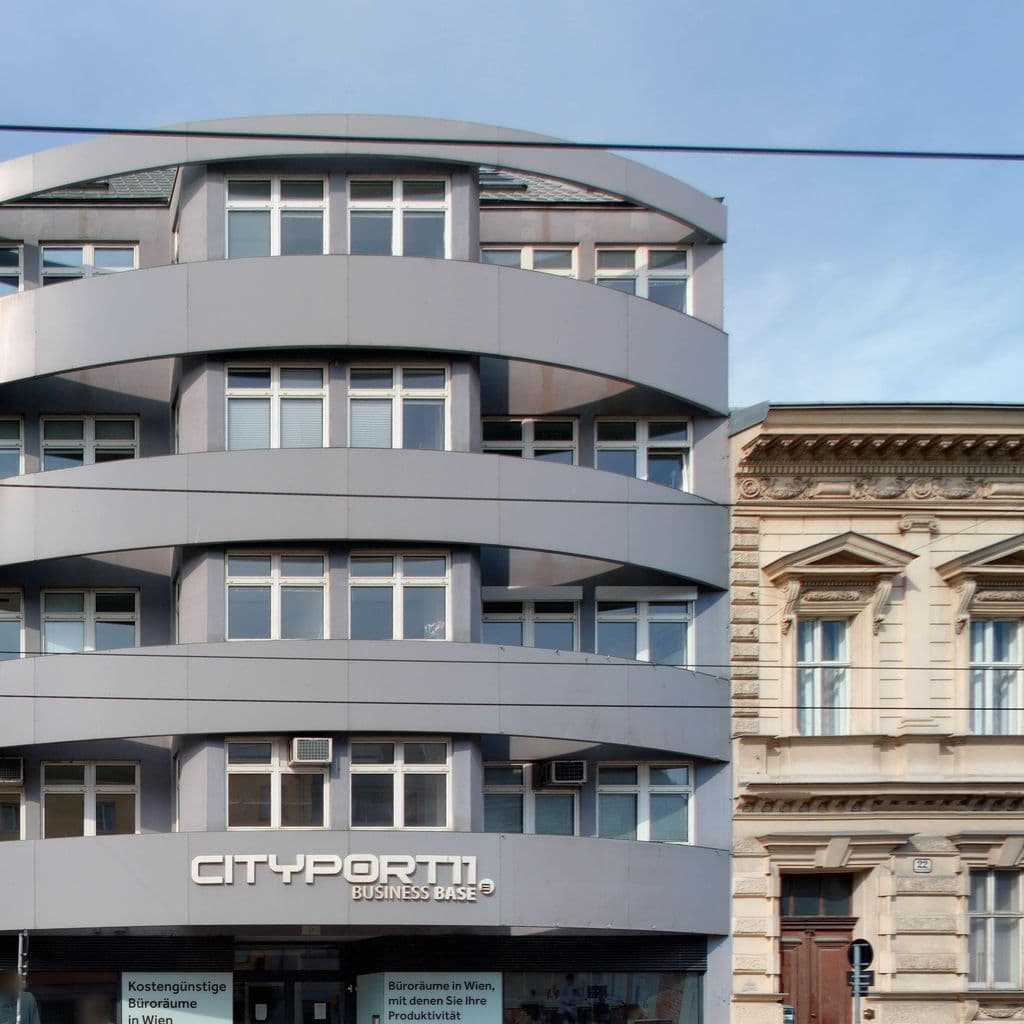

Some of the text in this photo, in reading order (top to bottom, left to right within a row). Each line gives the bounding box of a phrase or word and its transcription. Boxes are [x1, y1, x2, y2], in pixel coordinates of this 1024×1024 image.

[191, 854, 477, 885] CITYPORT11
[352, 884, 477, 901] BUSINESS BASE
[128, 981, 227, 994] Kostengünstige
[389, 981, 495, 992] Büroräume in Wien,
[128, 998, 198, 1009] Büroräume
[389, 996, 487, 1005] mit denen Sie Ihre
[128, 1014, 173, 1024] in Wien
[389, 1011, 461, 1020] Produktivität
